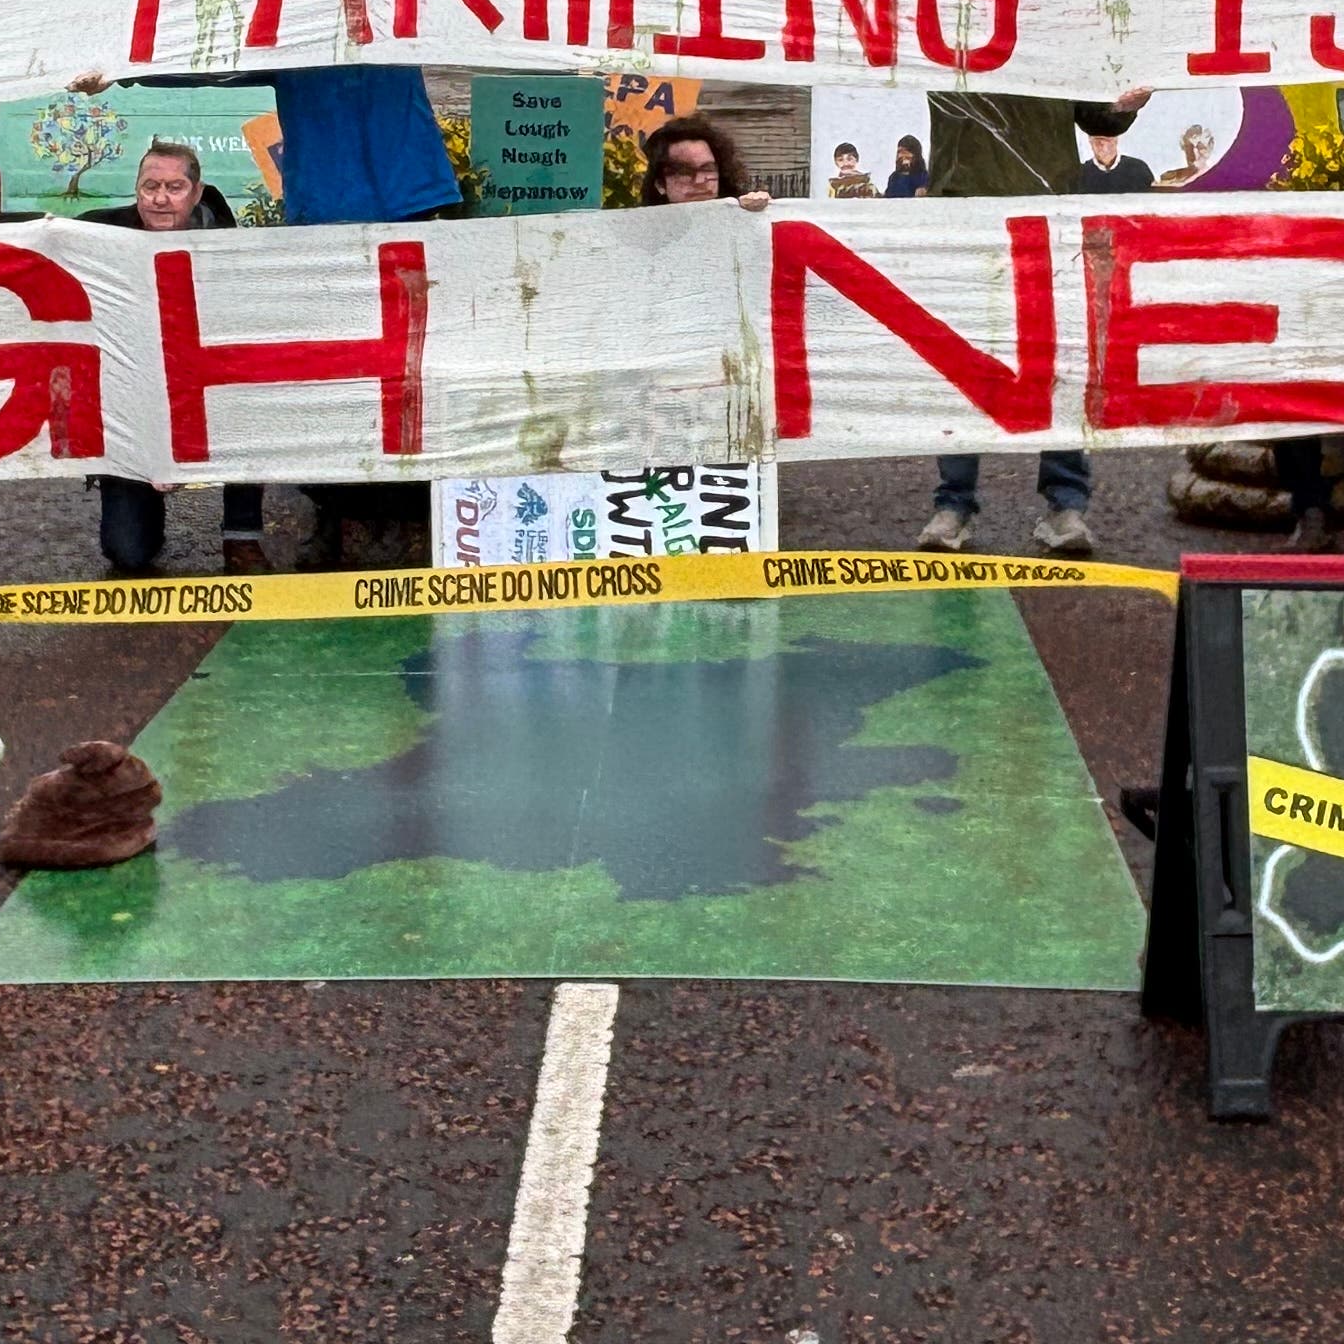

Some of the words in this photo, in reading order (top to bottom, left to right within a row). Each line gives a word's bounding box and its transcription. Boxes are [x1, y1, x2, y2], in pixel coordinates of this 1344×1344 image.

[512, 91, 562, 109] Save
[505, 119, 571, 140] Lough
[354, 577, 423, 609] CRIME
[428, 571, 497, 606] SCENE
[501, 570, 532, 602] DO
[537, 567, 583, 600] NOT
[586, 562, 662, 598] CROSS
[763, 558, 836, 588] CRIME
[838, 557, 912, 585] SCENE
[913, 560, 949, 582] DO
[953, 561, 998, 581] NOT
[21, 589, 91, 615] SCENE
[94, 587, 126, 615] DO
[131, 586, 176, 614] NOT
[179, 583, 253, 614] CROSS
